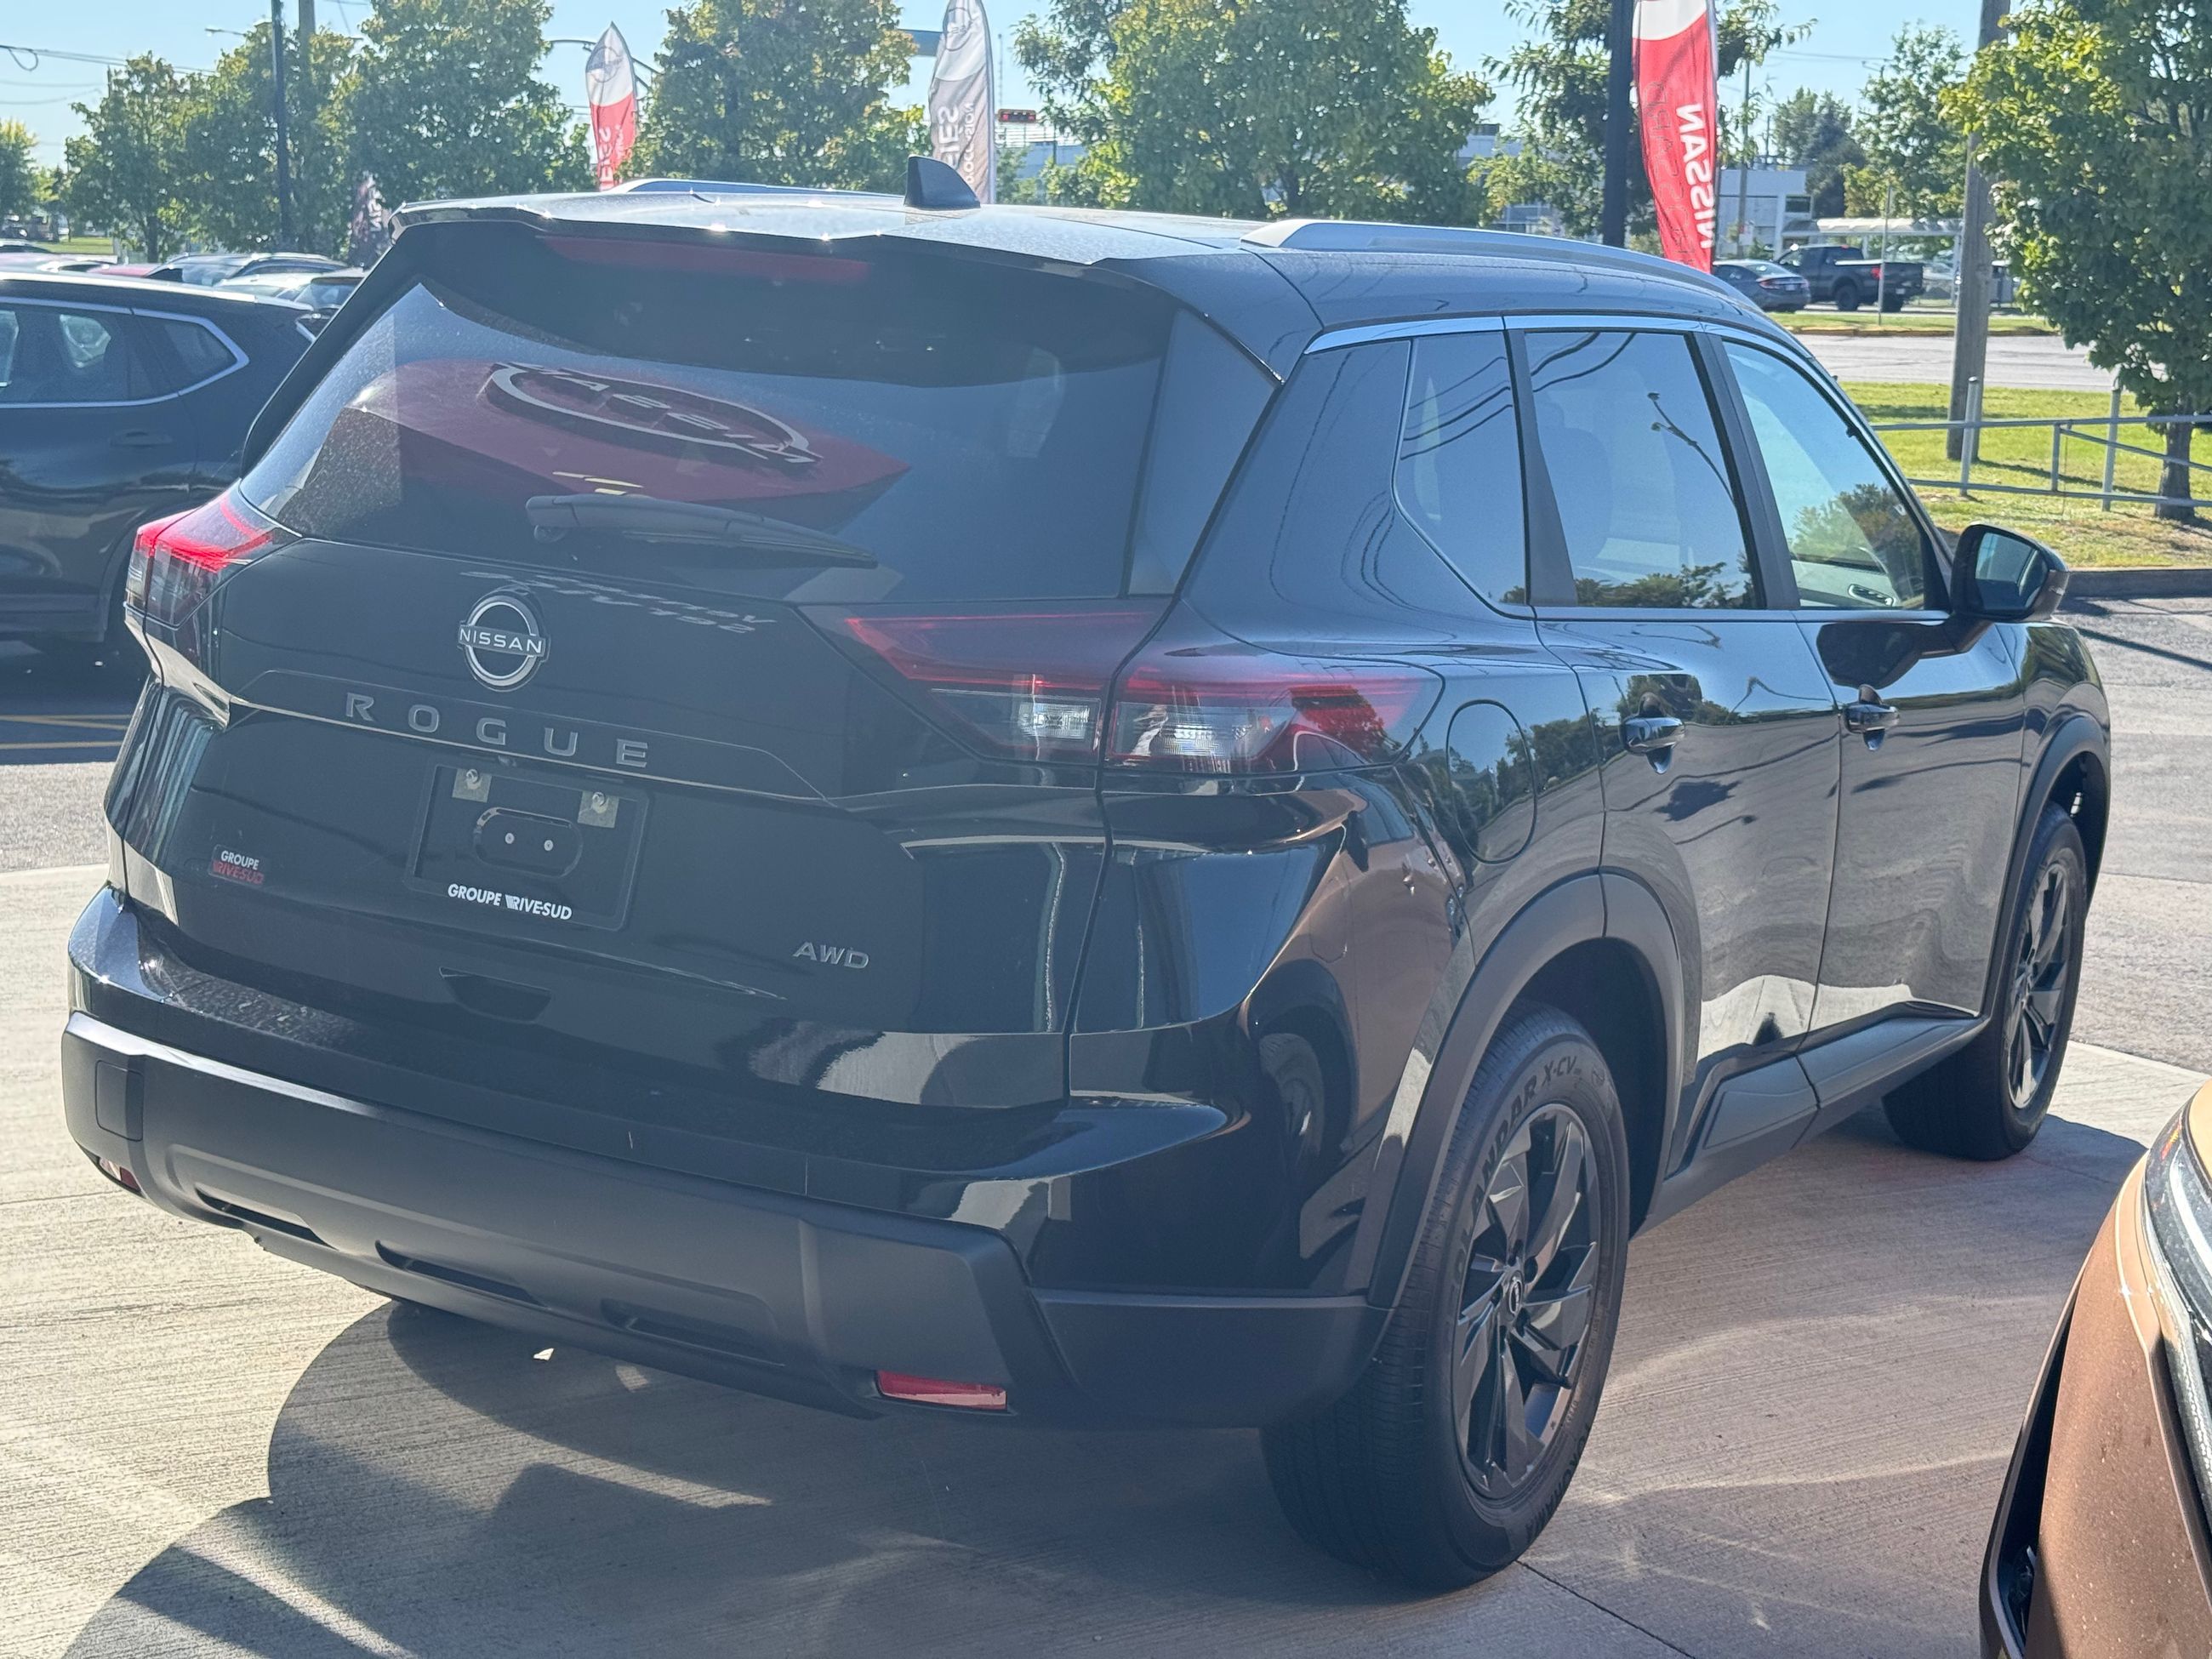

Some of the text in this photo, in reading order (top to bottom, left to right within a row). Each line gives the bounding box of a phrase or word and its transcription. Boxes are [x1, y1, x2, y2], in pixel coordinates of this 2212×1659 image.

[459, 628, 542, 654] NISSAN
[345, 692, 649, 768] ROGUE
[221, 850, 259, 871] GROUPE
[448, 883, 502, 906] GROUPE
[792, 941, 869, 969] AWD
[1542, 1056, 1576, 1087] X-CV
